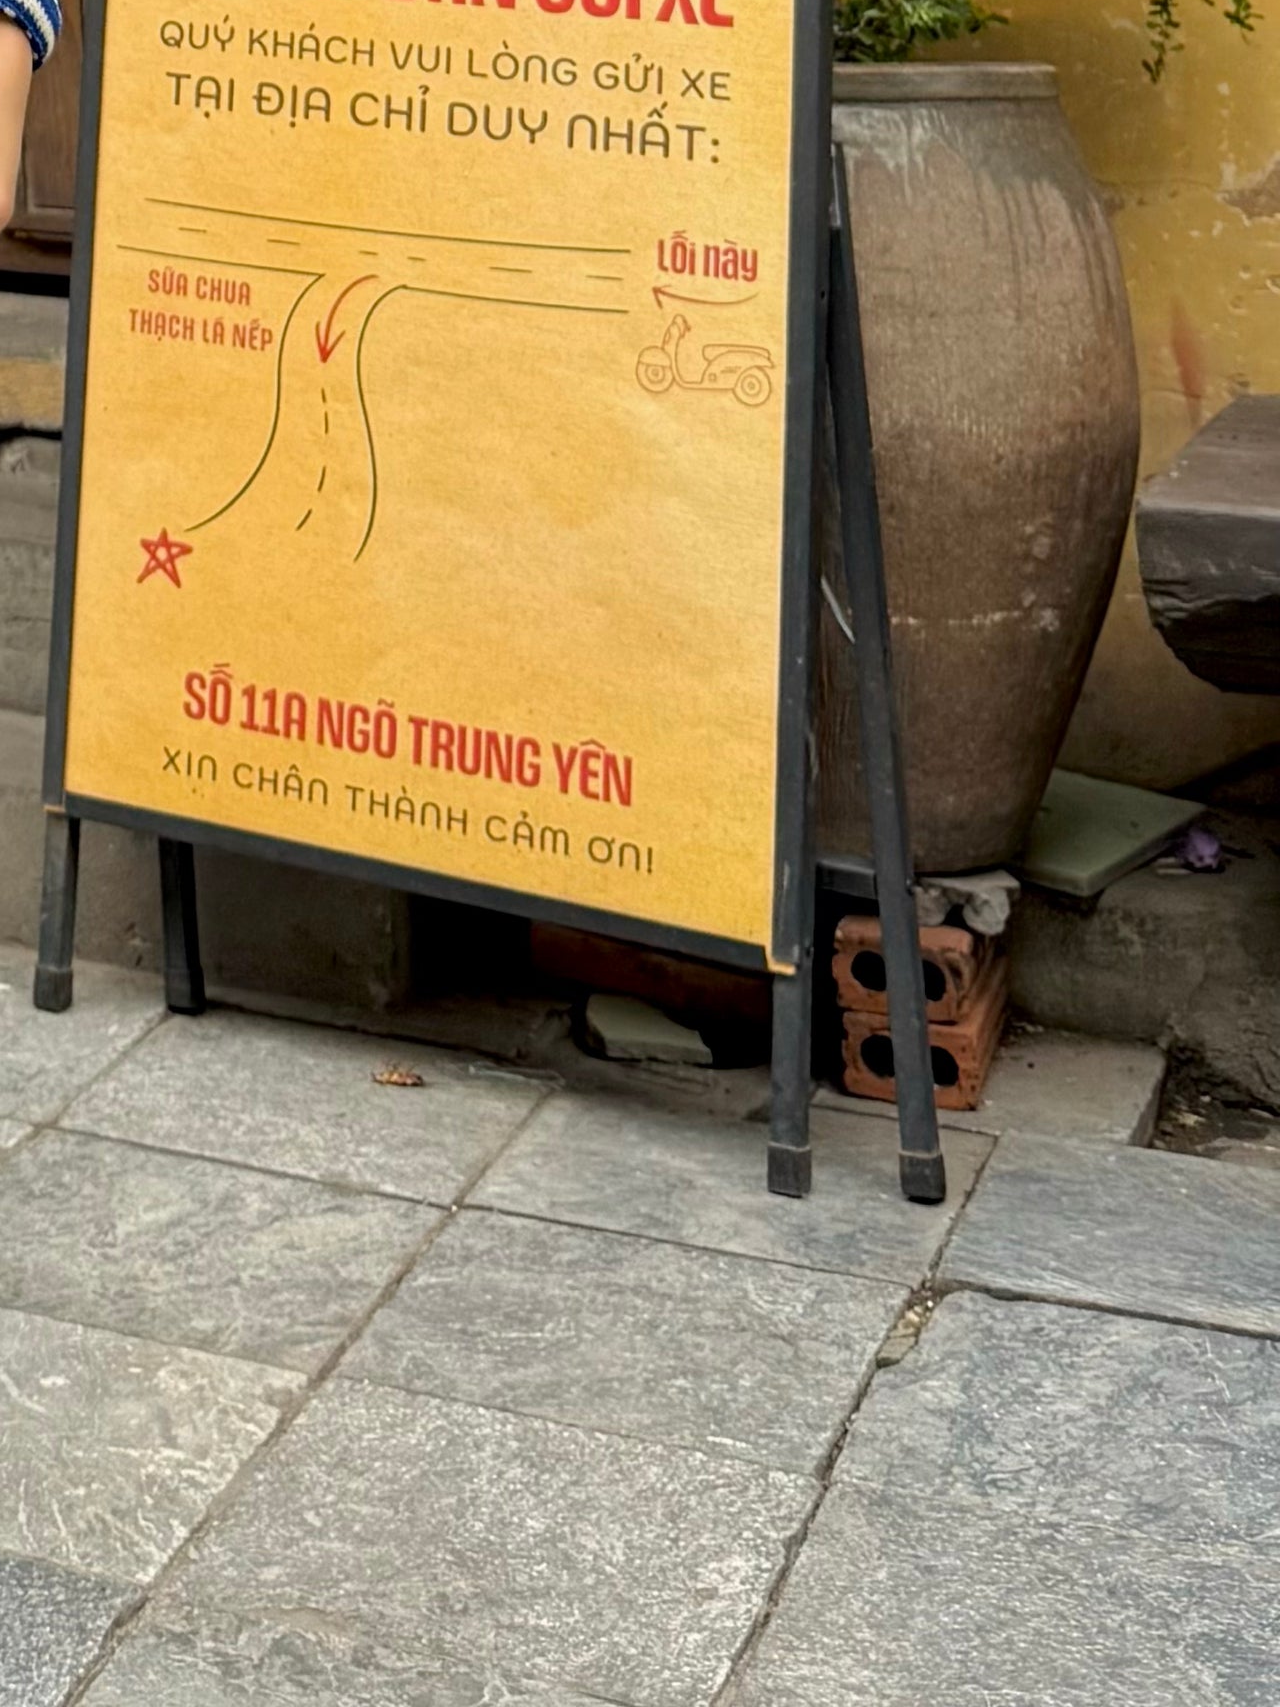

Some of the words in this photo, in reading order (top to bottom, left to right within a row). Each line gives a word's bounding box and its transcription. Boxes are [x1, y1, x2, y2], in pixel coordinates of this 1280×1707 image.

[159, 14, 235, 53] QUÝ
[248, 22, 376, 68] KHÁCH
[390, 42, 452, 76] VUI
[468, 40, 578, 85] LÒNG
[593, 54, 664, 96] GỬI
[680, 68, 732, 102] XE
[165, 71, 235, 120] TẠI
[252, 81, 332, 130] ĐỊA
[349, 85, 431, 133] CHỈ
[446, 101, 549, 145] DUY
[196, 275, 251, 306] CHUA
[703, 239, 758, 283] này
[129, 308, 195, 342] THẠCH
[183, 662, 233, 727] SỐ
[240, 684, 307, 742] 11A
[317, 697, 397, 759] NGÕ
[408, 715, 541, 788] TRUNG
[552, 738, 633, 807] YÊN
[162, 745, 218, 782] XIN
[232, 763, 329, 807] CHÂN
[345, 785, 468, 836] THÀNH
[485, 810, 570, 857] CẢM
